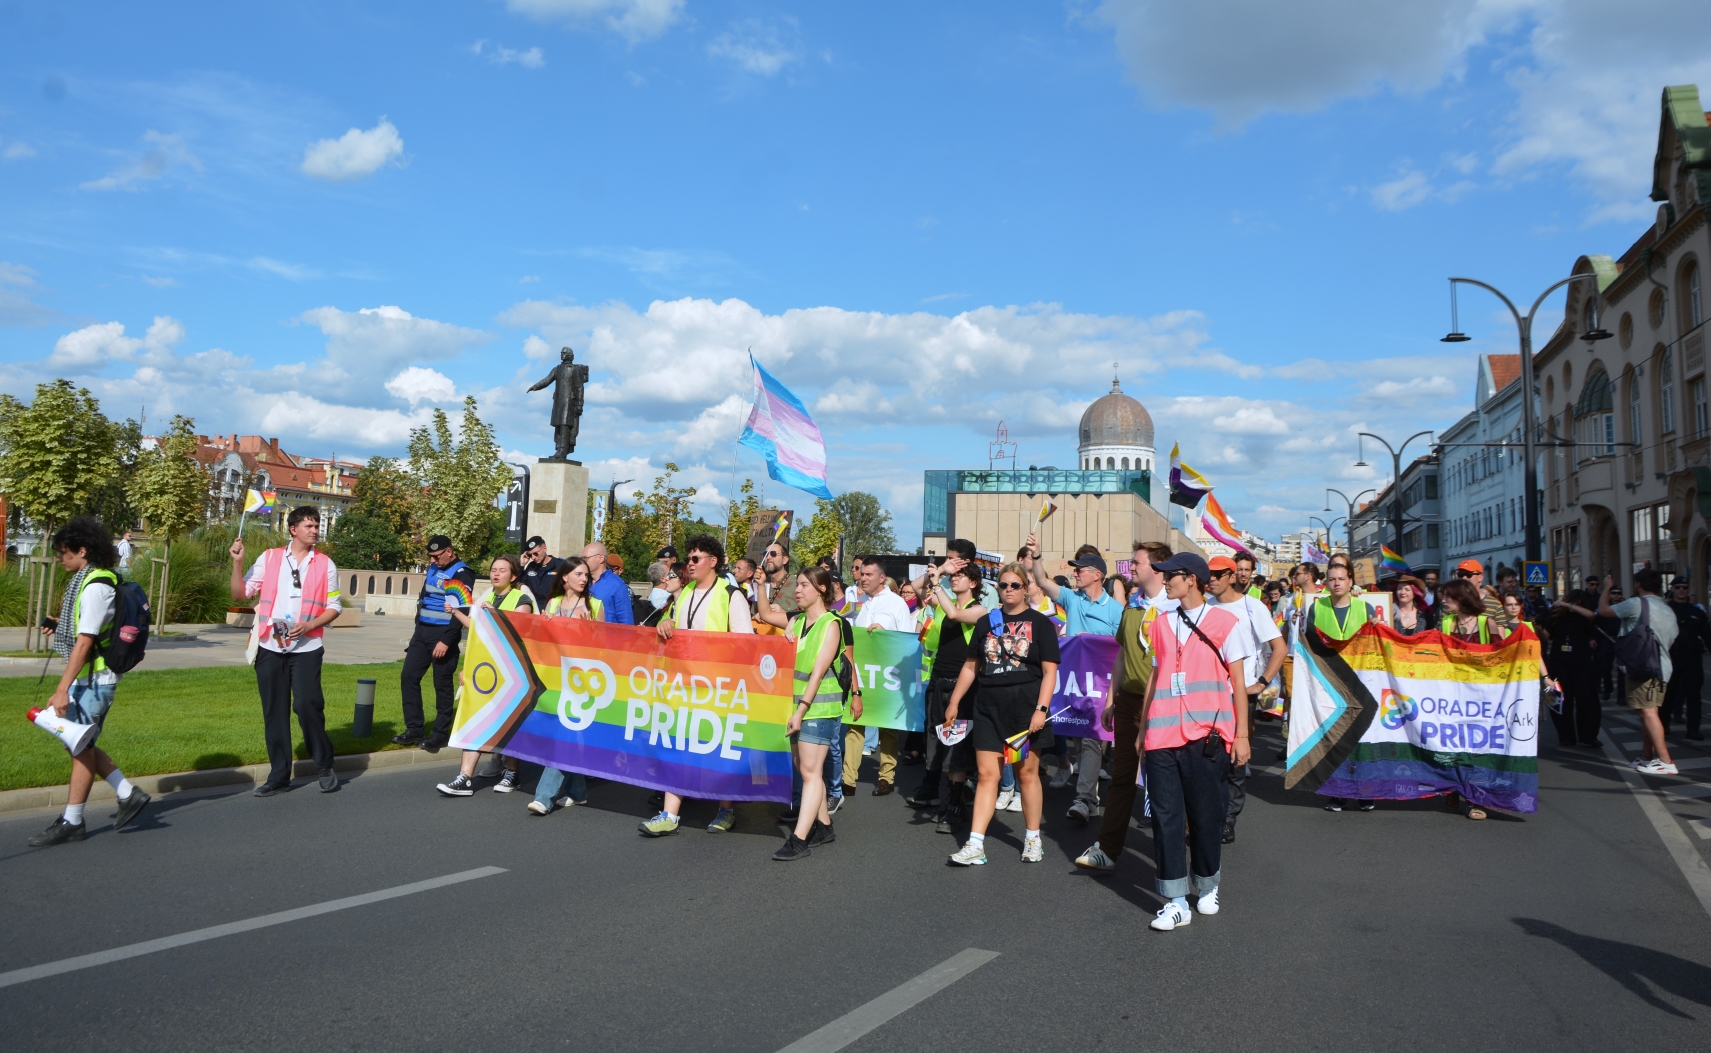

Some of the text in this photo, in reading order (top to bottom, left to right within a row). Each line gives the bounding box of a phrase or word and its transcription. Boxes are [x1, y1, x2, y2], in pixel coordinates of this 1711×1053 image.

[629, 666, 749, 711] ORADEA
[1053, 669, 1112, 698] AL
[1420, 696, 1506, 719] ORADEA
[1511, 712, 1534, 727] Ark
[624, 697, 748, 761] PRIDE
[1420, 721, 1505, 750] PRIDE
